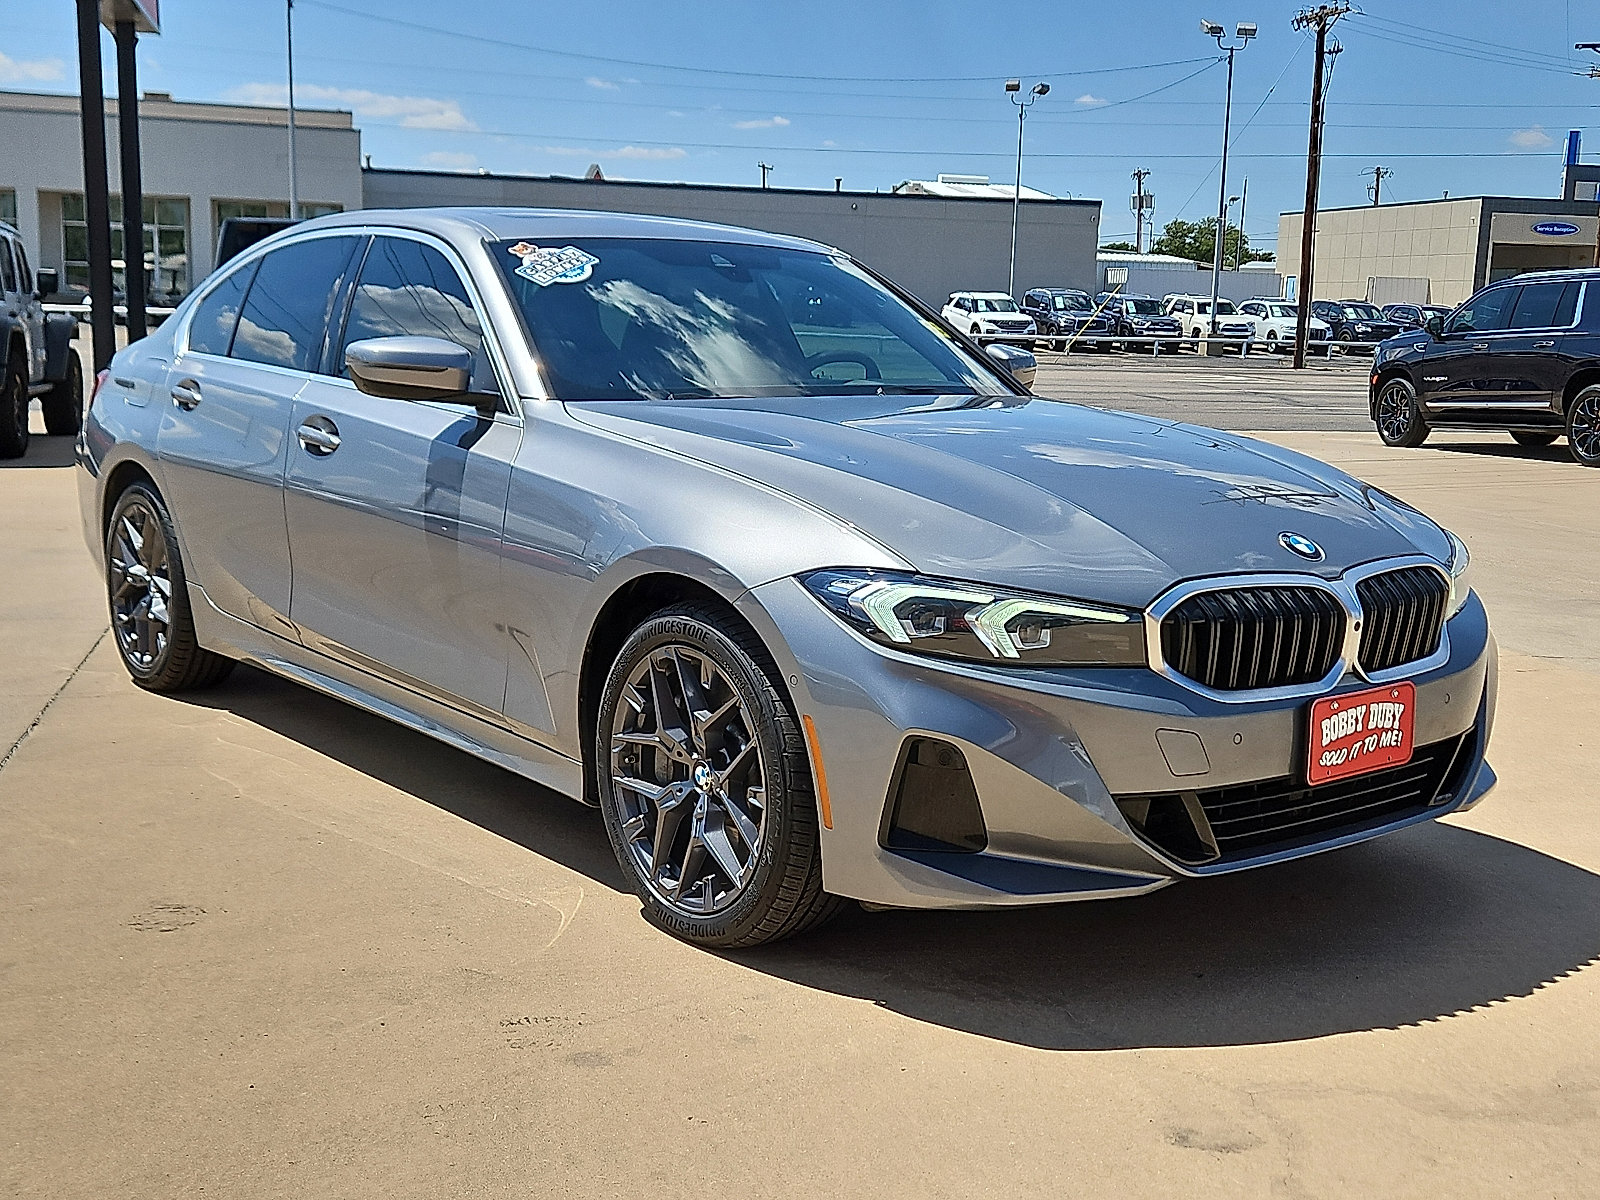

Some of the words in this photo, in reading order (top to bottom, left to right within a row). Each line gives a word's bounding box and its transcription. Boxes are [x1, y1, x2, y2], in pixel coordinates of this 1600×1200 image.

[641, 619, 711, 645] BRIDGESTONE
[1321, 704, 1367, 747] BOBBY
[1368, 702, 1405, 730] DUBY
[1319, 747, 1348, 767] SOLD
[1348, 740, 1363, 762] IT
[1363, 733, 1379, 756] TO
[1379, 730, 1403, 749] ME!
